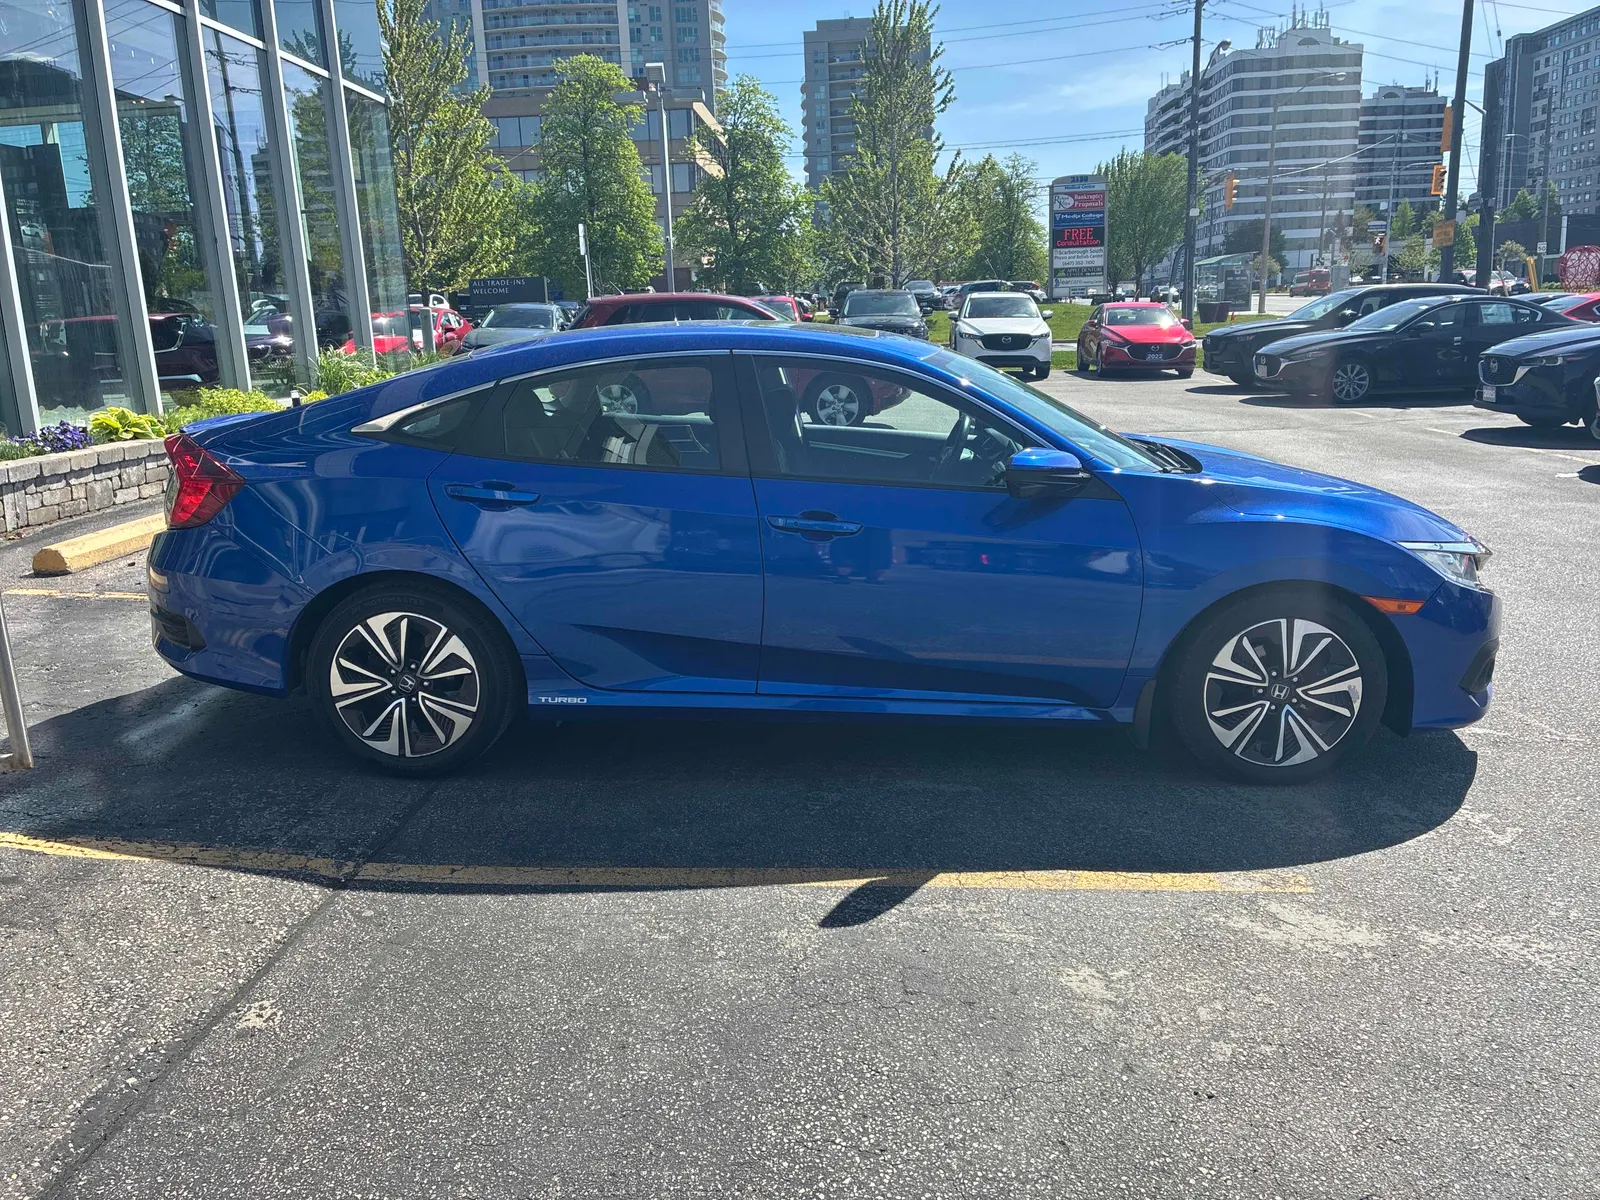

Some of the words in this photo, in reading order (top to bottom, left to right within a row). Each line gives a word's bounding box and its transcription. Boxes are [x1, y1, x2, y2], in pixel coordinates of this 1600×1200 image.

[1063, 228, 1094, 240] FREE
[1056, 239, 1101, 247] Consultation
[487, 279, 526, 287] TRADE-INS
[472, 287, 510, 295] WELCOME
[538, 696, 588, 704] TURBO
